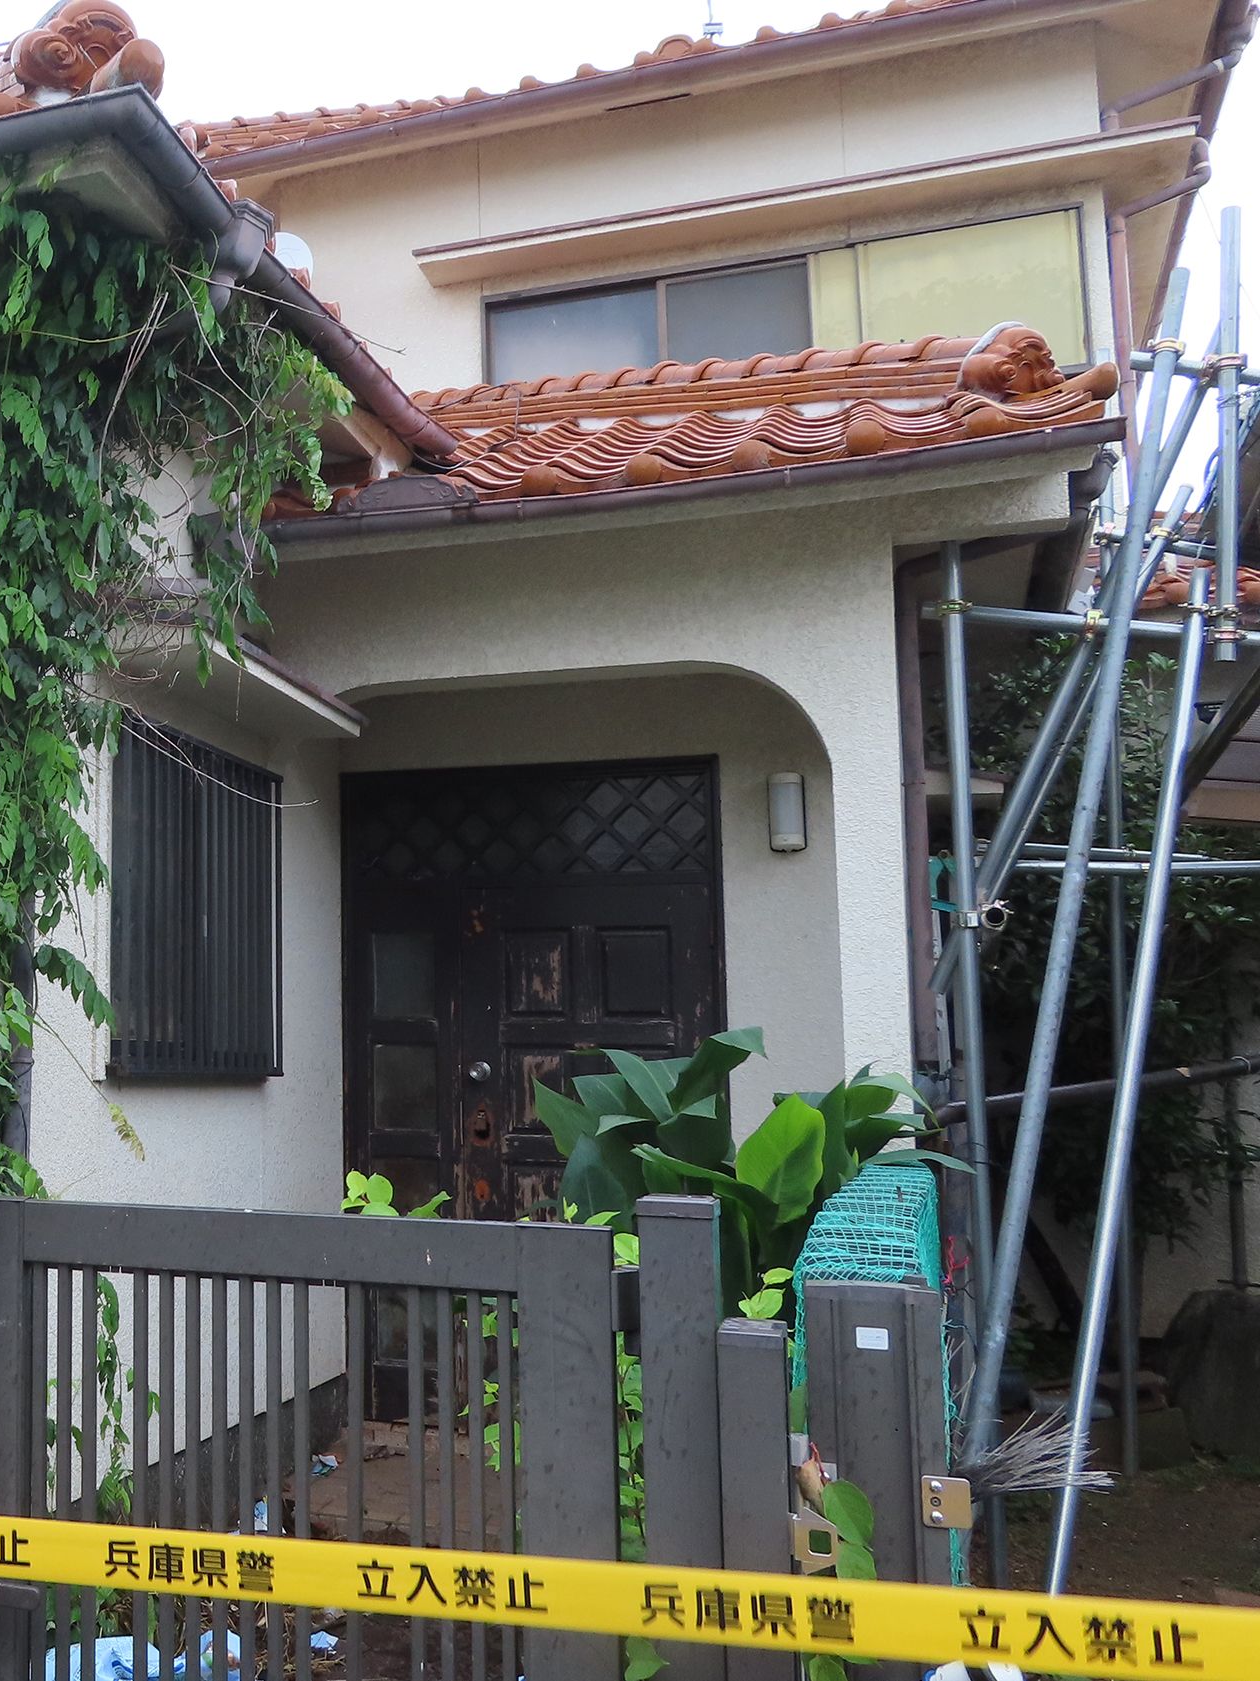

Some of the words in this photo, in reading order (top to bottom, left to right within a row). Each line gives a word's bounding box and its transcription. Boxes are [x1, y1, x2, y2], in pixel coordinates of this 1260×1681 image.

[104, 1540, 275, 1592] 兵庫県警
[357, 1558, 548, 1612] 立入禁止
[642, 1583, 854, 1641] 兵庫県警
[961, 1608, 1199, 1667] 立入禁止
